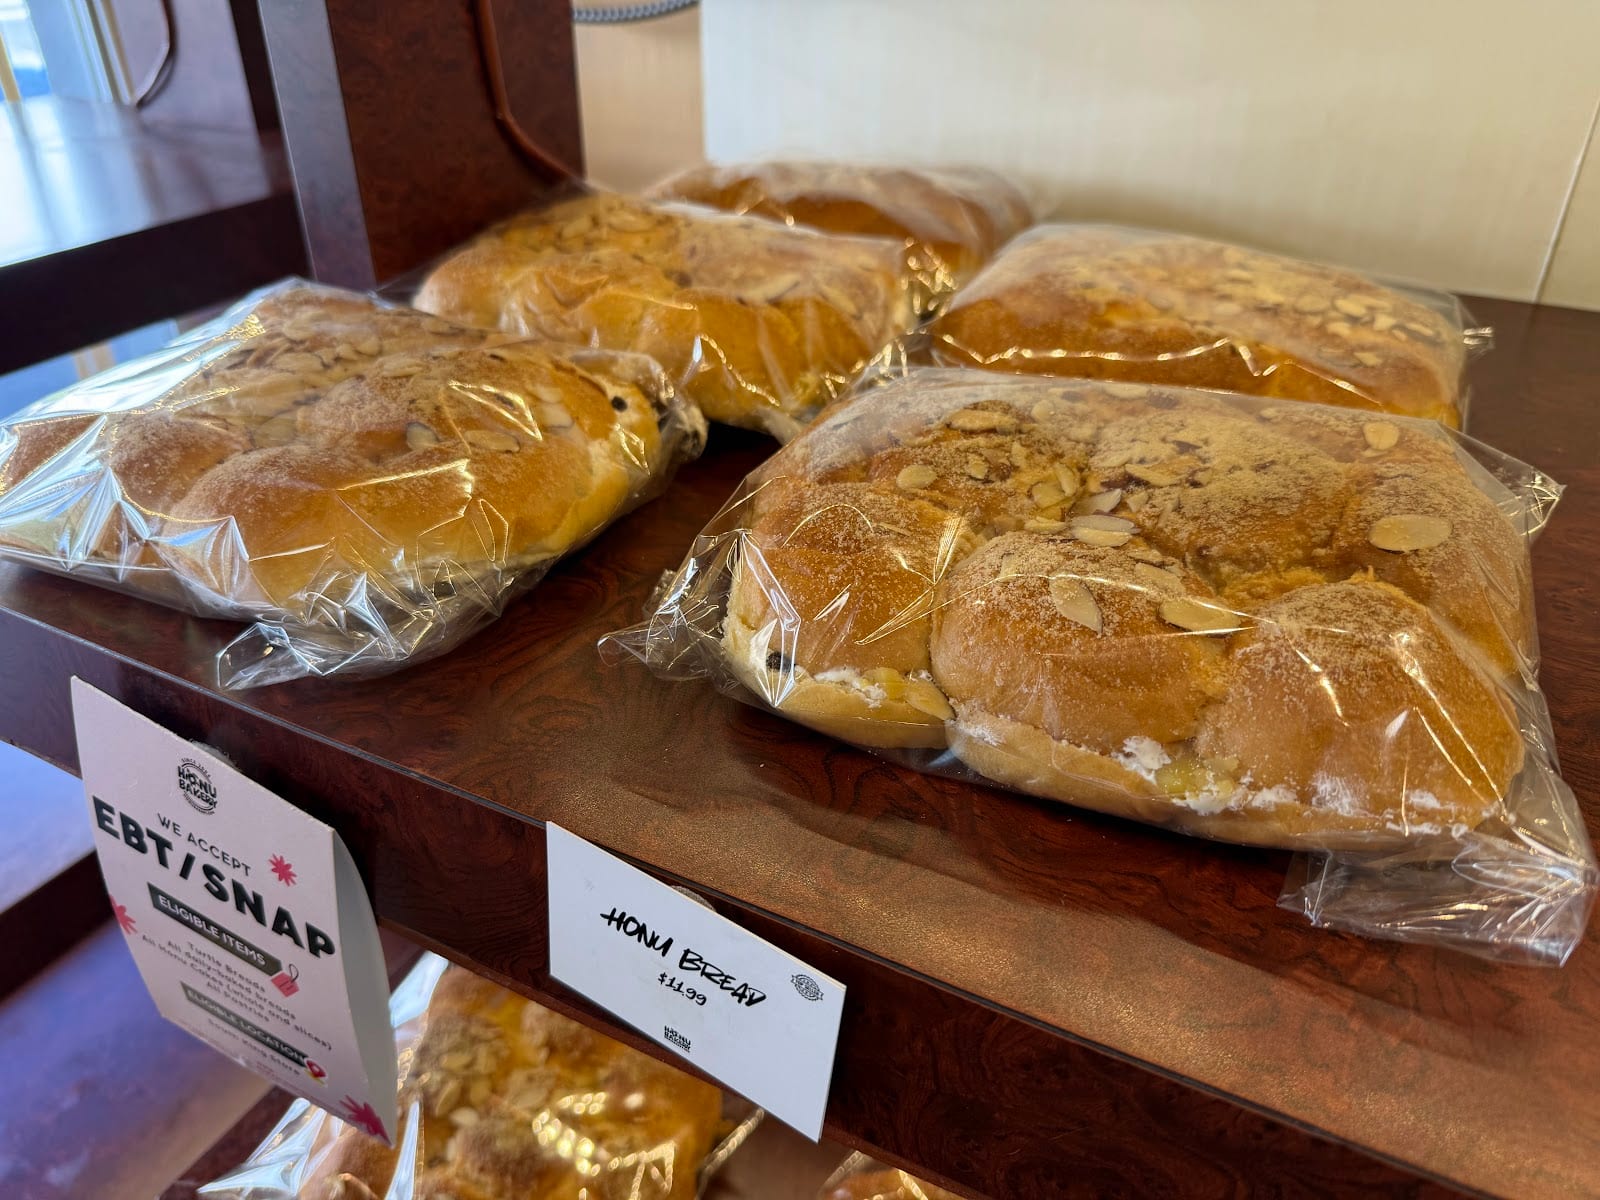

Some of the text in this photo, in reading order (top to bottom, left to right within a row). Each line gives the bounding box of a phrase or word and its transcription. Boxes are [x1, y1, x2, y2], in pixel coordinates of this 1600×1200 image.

[178, 766, 217, 799] HONU
[179, 779, 218, 809] BAKERY
[157, 812, 252, 877] WE ACCEPT
[92, 795, 336, 958] EBT/SNAP
[159, 895, 267, 966] ELIGIBLE ITEMS
[599, 907, 767, 1007] HONU BREAD
[142, 934, 156, 947] All
[189, 961, 224, 986] Cakes
[268, 1007, 291, 1026] and
[294, 1025, 332, 1051] slices)
[167, 940, 182, 952] All
[255, 991, 296, 1020] breads
[187, 941, 266, 993] Turtle Breads
[657, 972, 708, 1006] $11.99
[206, 981, 270, 1022] All Pastries
[270, 1053, 301, 1076] Store
